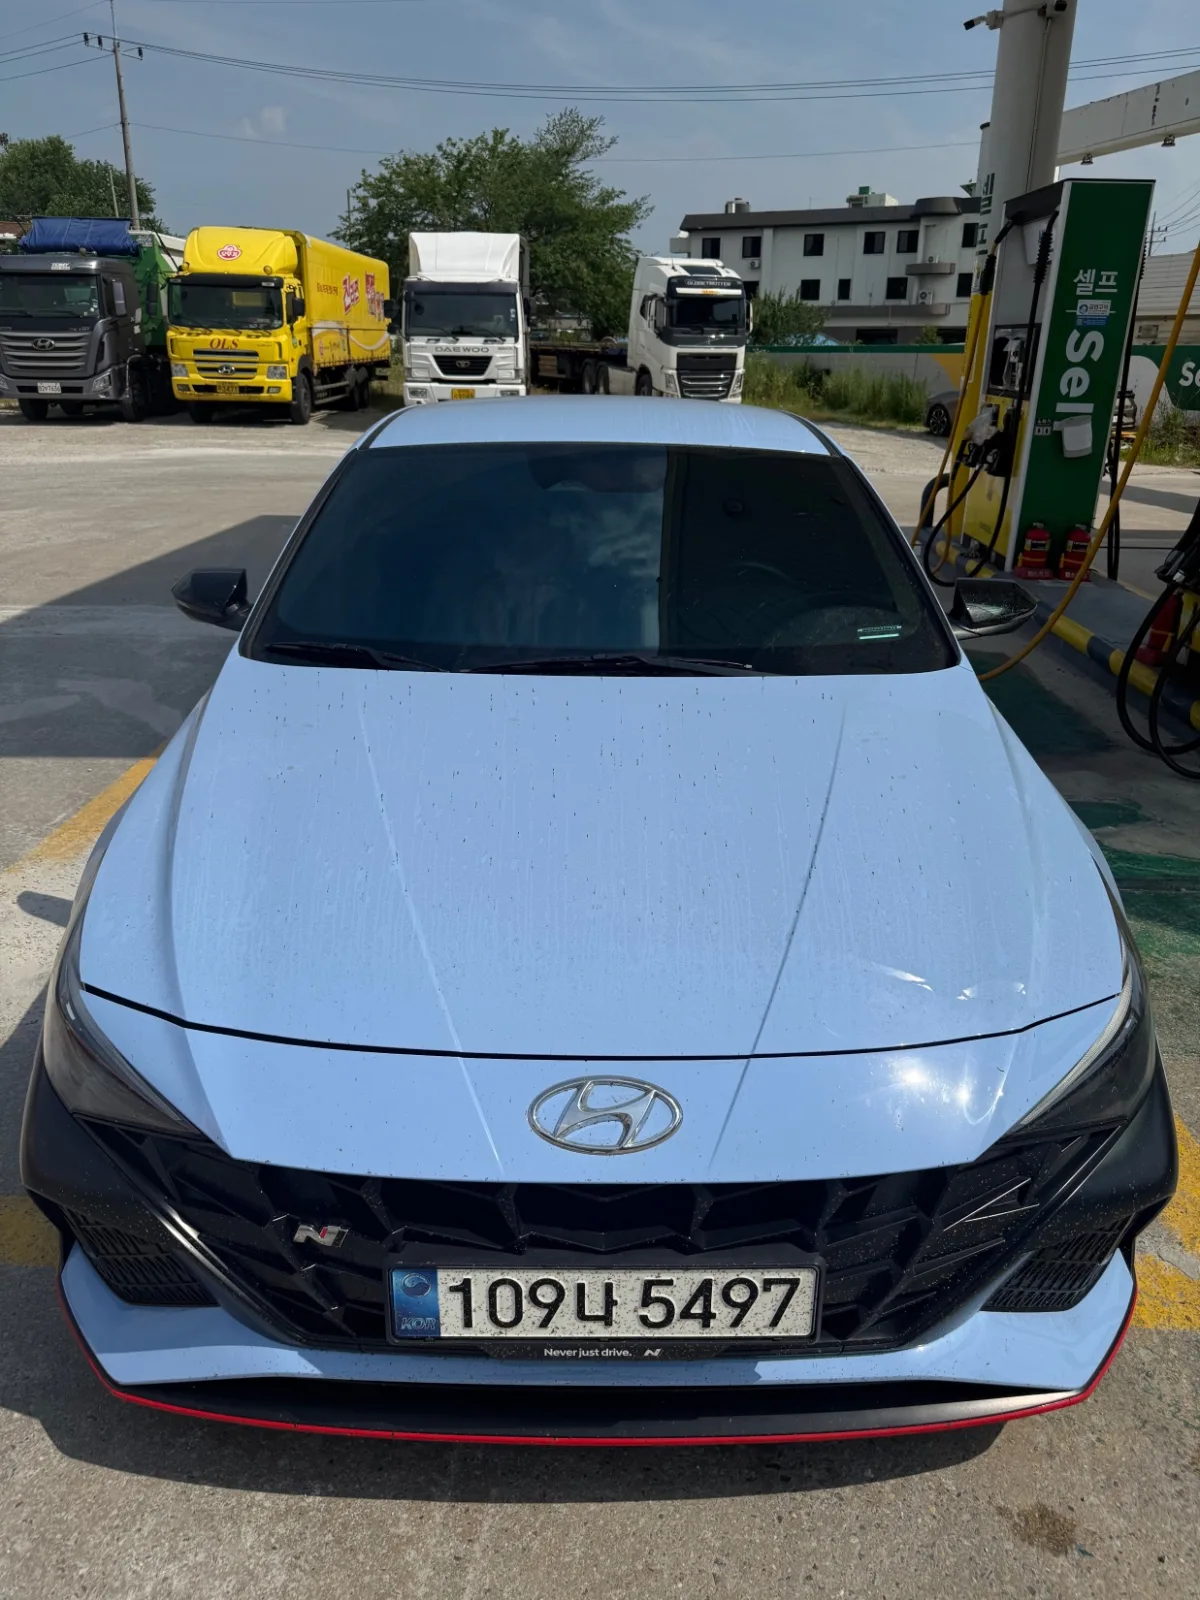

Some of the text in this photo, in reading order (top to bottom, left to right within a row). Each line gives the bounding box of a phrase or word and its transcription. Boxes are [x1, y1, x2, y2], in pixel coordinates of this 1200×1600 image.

[1073, 268, 1118, 296] 셀프
[209, 338, 239, 350] OLS
[1054, 329, 1105, 432] Sel
[449, 1277, 801, 1329] 109나 5497
[400, 1317, 437, 1331] KOR
[543, 1348, 578, 1357] Never
[578, 1348, 600, 1358] just
[600, 1348, 632, 1357] drive.
